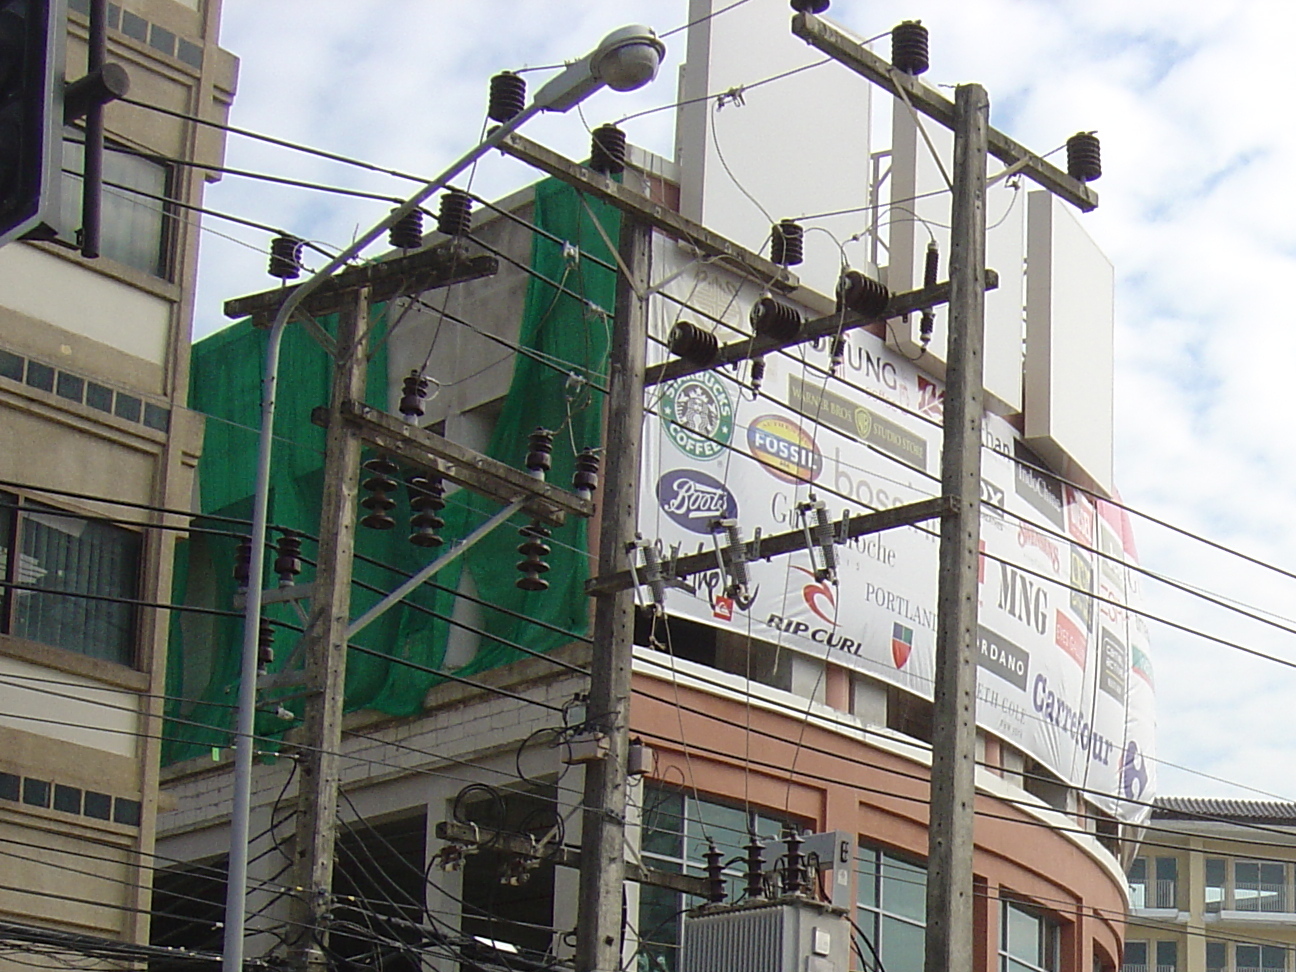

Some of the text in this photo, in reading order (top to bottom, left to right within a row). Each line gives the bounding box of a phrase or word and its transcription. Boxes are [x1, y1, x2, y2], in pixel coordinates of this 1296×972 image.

[669, 423, 722, 456] COFFEE
[755, 432, 818, 470] FOSSIL
[664, 478, 728, 515] Boots
[866, 582, 938, 632] PORTLAN
[997, 562, 1048, 636] MNG
[766, 613, 863, 657] RIP CURL
[977, 637, 1025, 677] RDANO
[1032, 673, 1114, 767] Carrefour
